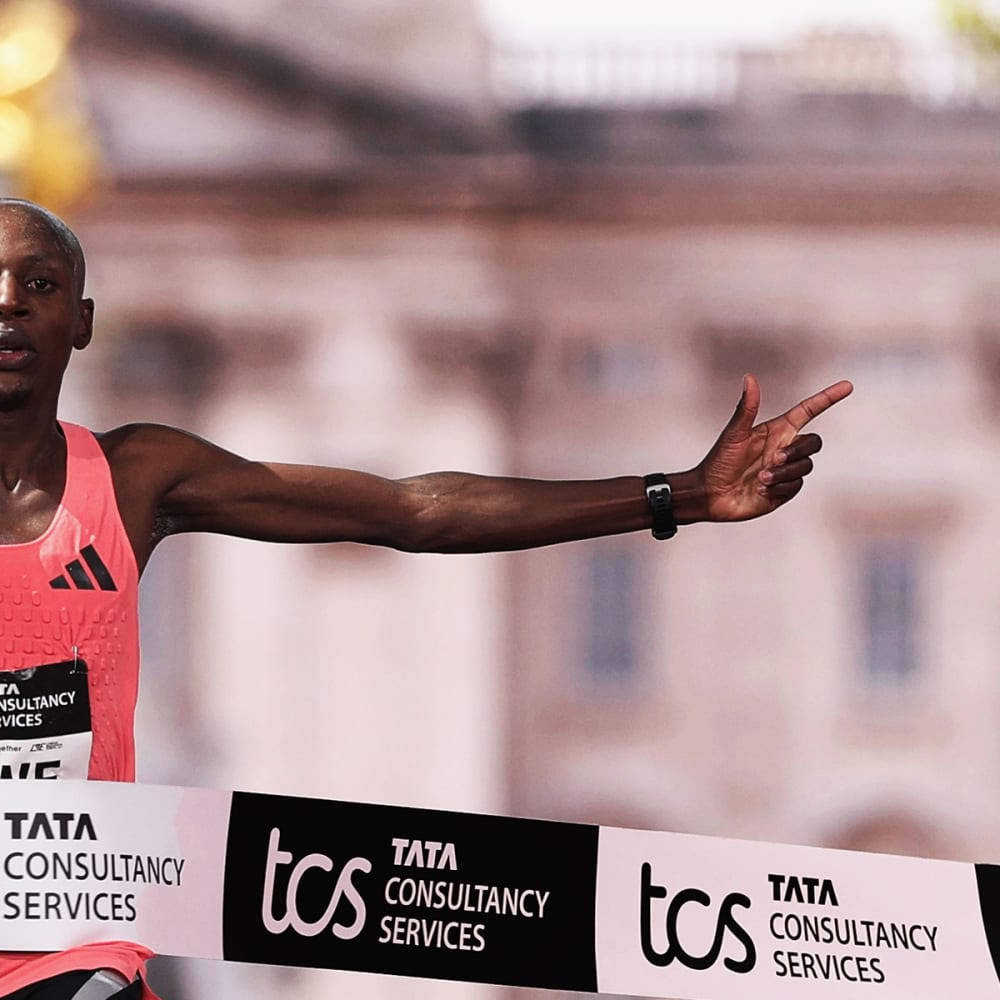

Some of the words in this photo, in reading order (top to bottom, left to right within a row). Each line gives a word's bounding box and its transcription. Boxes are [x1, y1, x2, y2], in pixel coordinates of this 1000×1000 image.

[5, 813, 97, 840] TATA
[4, 852, 185, 886] CONSULTANCY
[392, 838, 457, 870] TATA
[262, 828, 371, 939] tcs
[384, 877, 550, 918] CONSULTANCY
[768, 874, 839, 906] TATA
[4, 892, 137, 921] SERVICES
[641, 862, 756, 973] tcs
[378, 915, 486, 951] SERVICES
[769, 912, 938, 951] CONSULTANCY
[773, 951, 885, 983] SERVICES
